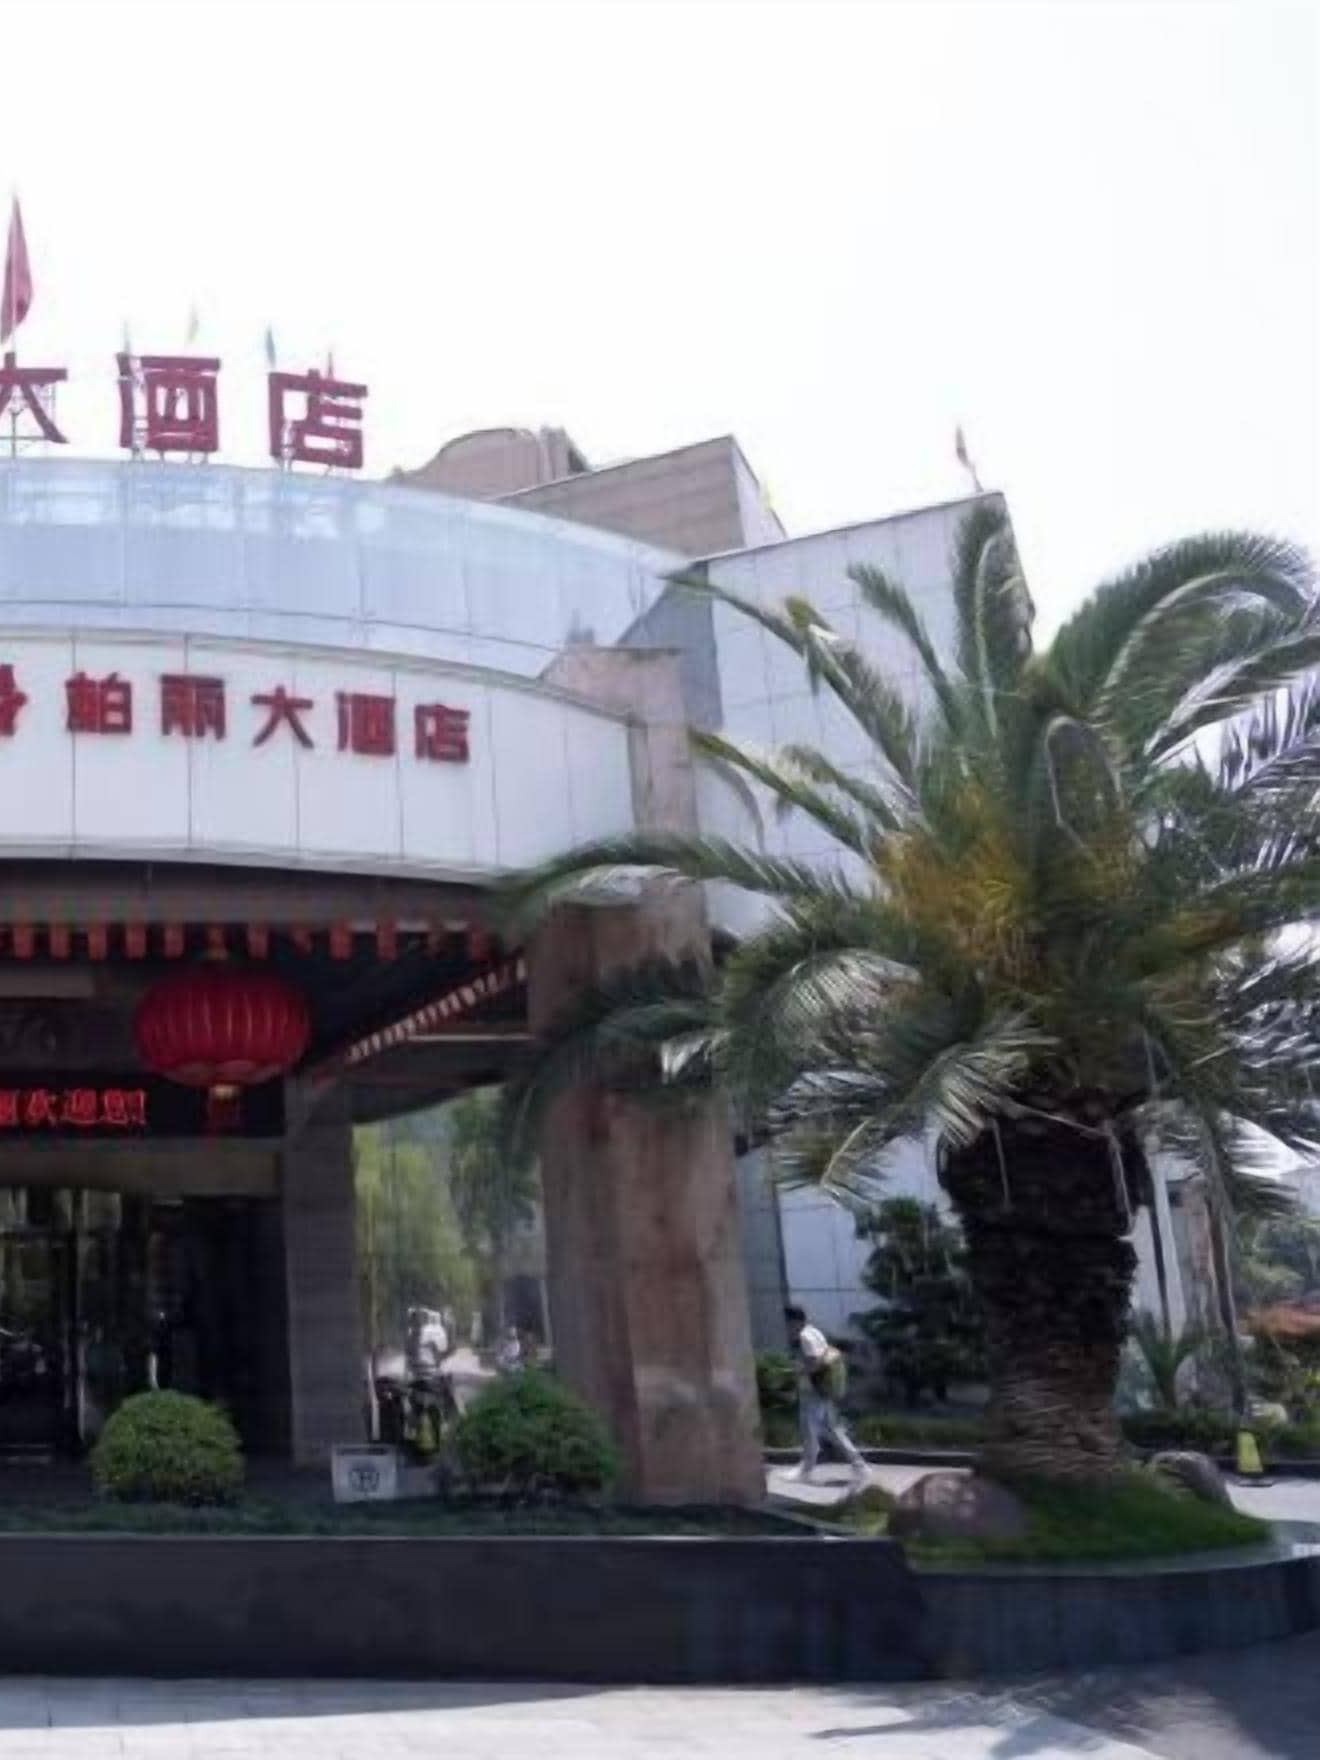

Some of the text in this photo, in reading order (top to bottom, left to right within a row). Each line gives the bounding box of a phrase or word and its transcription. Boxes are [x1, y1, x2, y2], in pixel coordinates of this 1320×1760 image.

[64, 671, 470, 764] 柏丽大酒店
